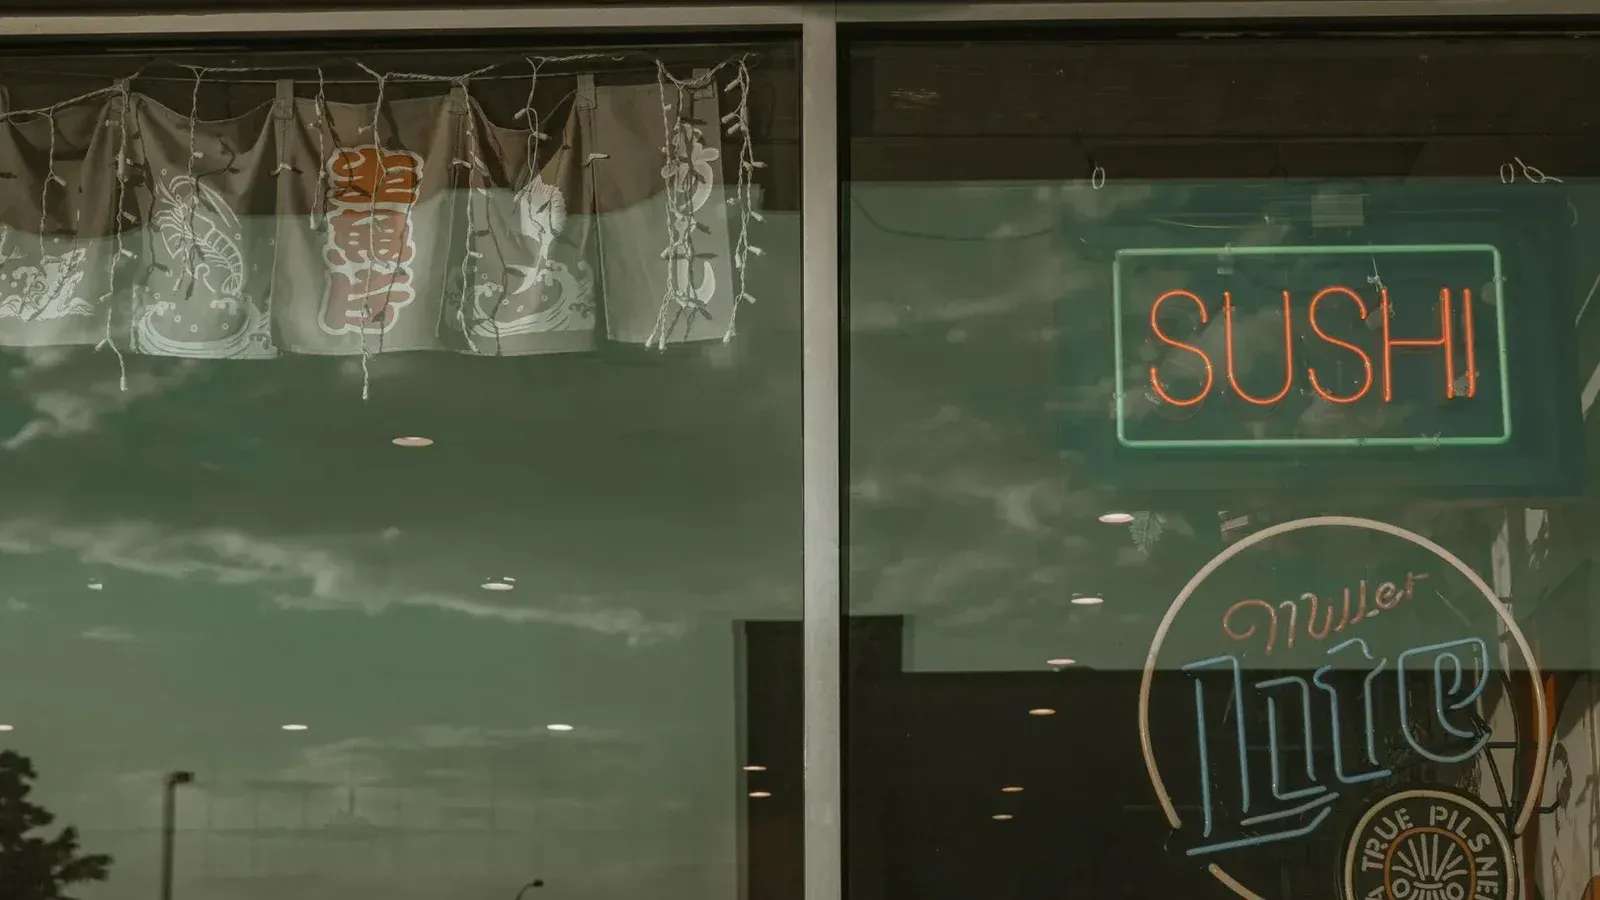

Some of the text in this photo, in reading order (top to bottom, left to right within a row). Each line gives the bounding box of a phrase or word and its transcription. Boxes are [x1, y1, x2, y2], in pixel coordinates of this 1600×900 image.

[1151, 286, 1476, 406] SUSHI
[1222, 572, 1430, 655] Miller
[1181, 637, 1492, 855] Lite
[1361, 807, 1414, 872] TRUE
